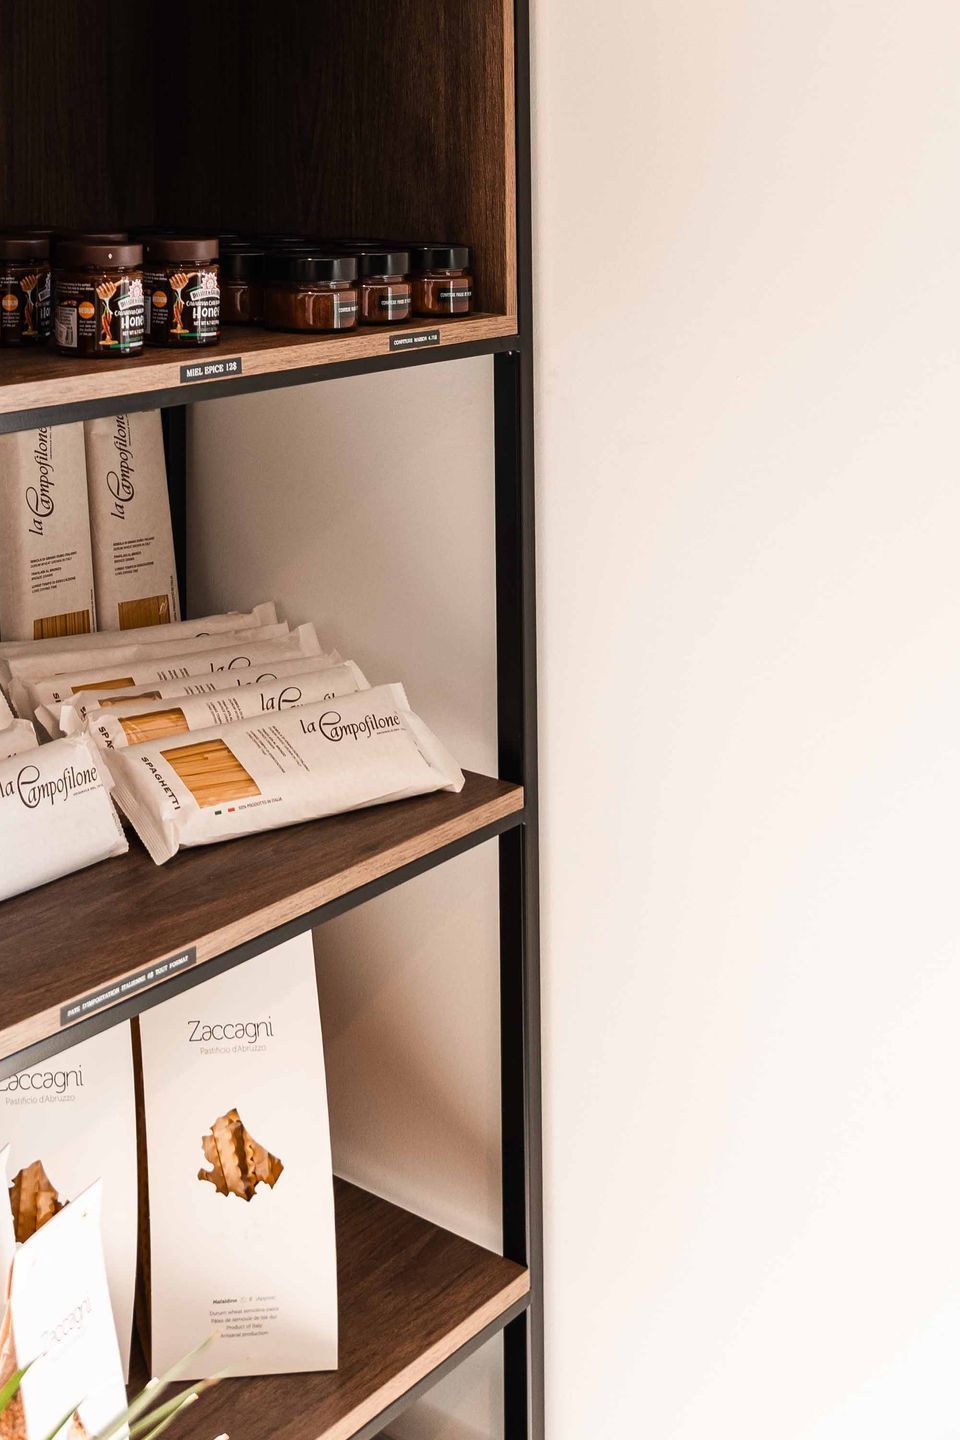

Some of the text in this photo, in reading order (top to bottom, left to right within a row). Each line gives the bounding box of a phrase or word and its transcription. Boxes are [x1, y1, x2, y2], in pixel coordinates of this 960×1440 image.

[186, 367, 203, 378] MIEL
[204, 364, 224, 375] EPICE
[111, 502, 125, 520] la
[28, 518, 43, 536] la
[261, 693, 275, 711] la
[300, 711, 400, 742] la Campofilone
[17, 765, 98, 808] Campofilone
[141, 756, 181, 810] SPAGHETTI
[155, 964, 168, 975] TOUT
[169, 955, 189, 969] FORMAT
[187, 1015, 274, 1044] Zaccagni
[200, 1043, 267, 1056] Pastificio d'Abruzzo
[5, 1093, 76, 1106] Pastificio d'Abruzzo
